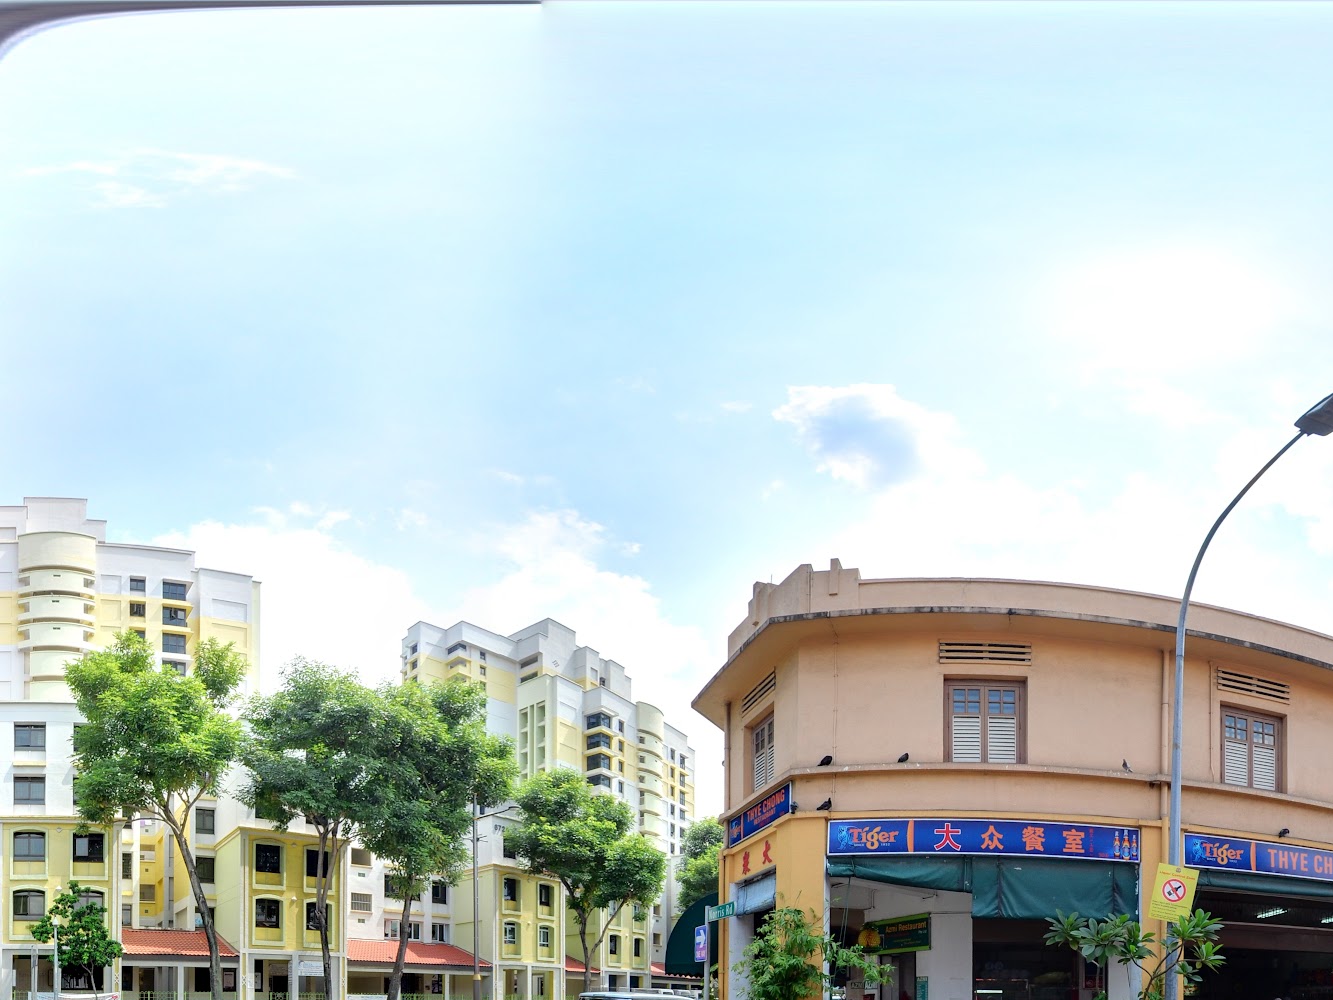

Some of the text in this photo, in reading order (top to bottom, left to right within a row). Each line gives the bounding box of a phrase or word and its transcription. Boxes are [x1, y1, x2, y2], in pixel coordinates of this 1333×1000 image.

[747, 803, 762, 822] THYE
[762, 789, 785, 813] CHONG
[849, 826, 899, 850] Tiger
[933, 823, 1086, 853] 大众餐室
[1202, 843, 1245, 865] Tiger
[1267, 848, 1309, 872] THYE
[709, 904, 733, 920] Norris Rd
[898, 921, 927, 931] Restaurant
